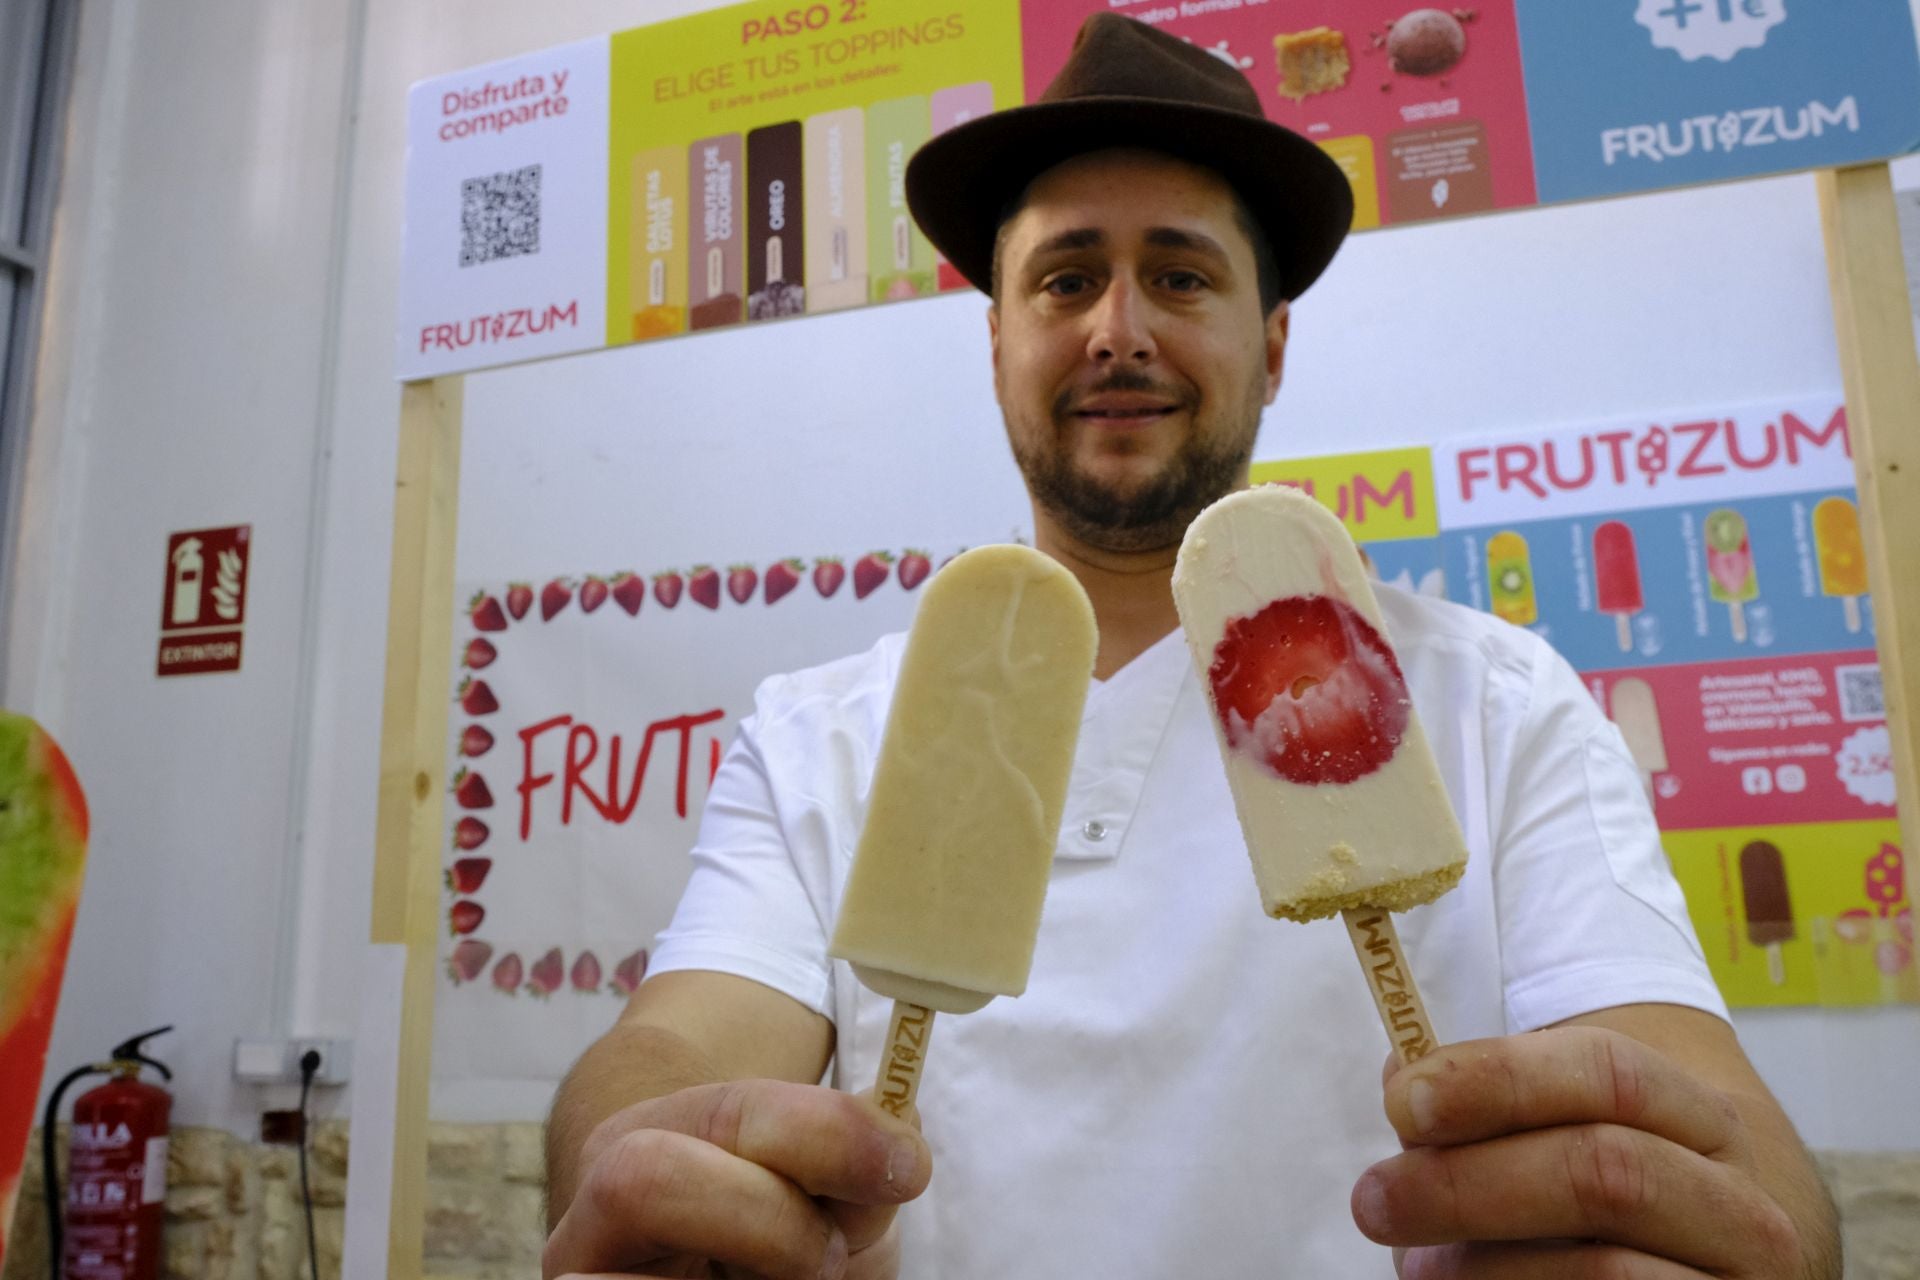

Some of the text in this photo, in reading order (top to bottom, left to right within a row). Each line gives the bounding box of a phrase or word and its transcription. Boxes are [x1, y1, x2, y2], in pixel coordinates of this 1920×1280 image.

[741, 4, 830, 45] PASO
[653, 13, 965, 102] ELIGE TUS TOPPINGS
[441, 69, 570, 117] Disfruta y
[439, 94, 570, 142] comparte
[768, 179, 785, 231] OREO
